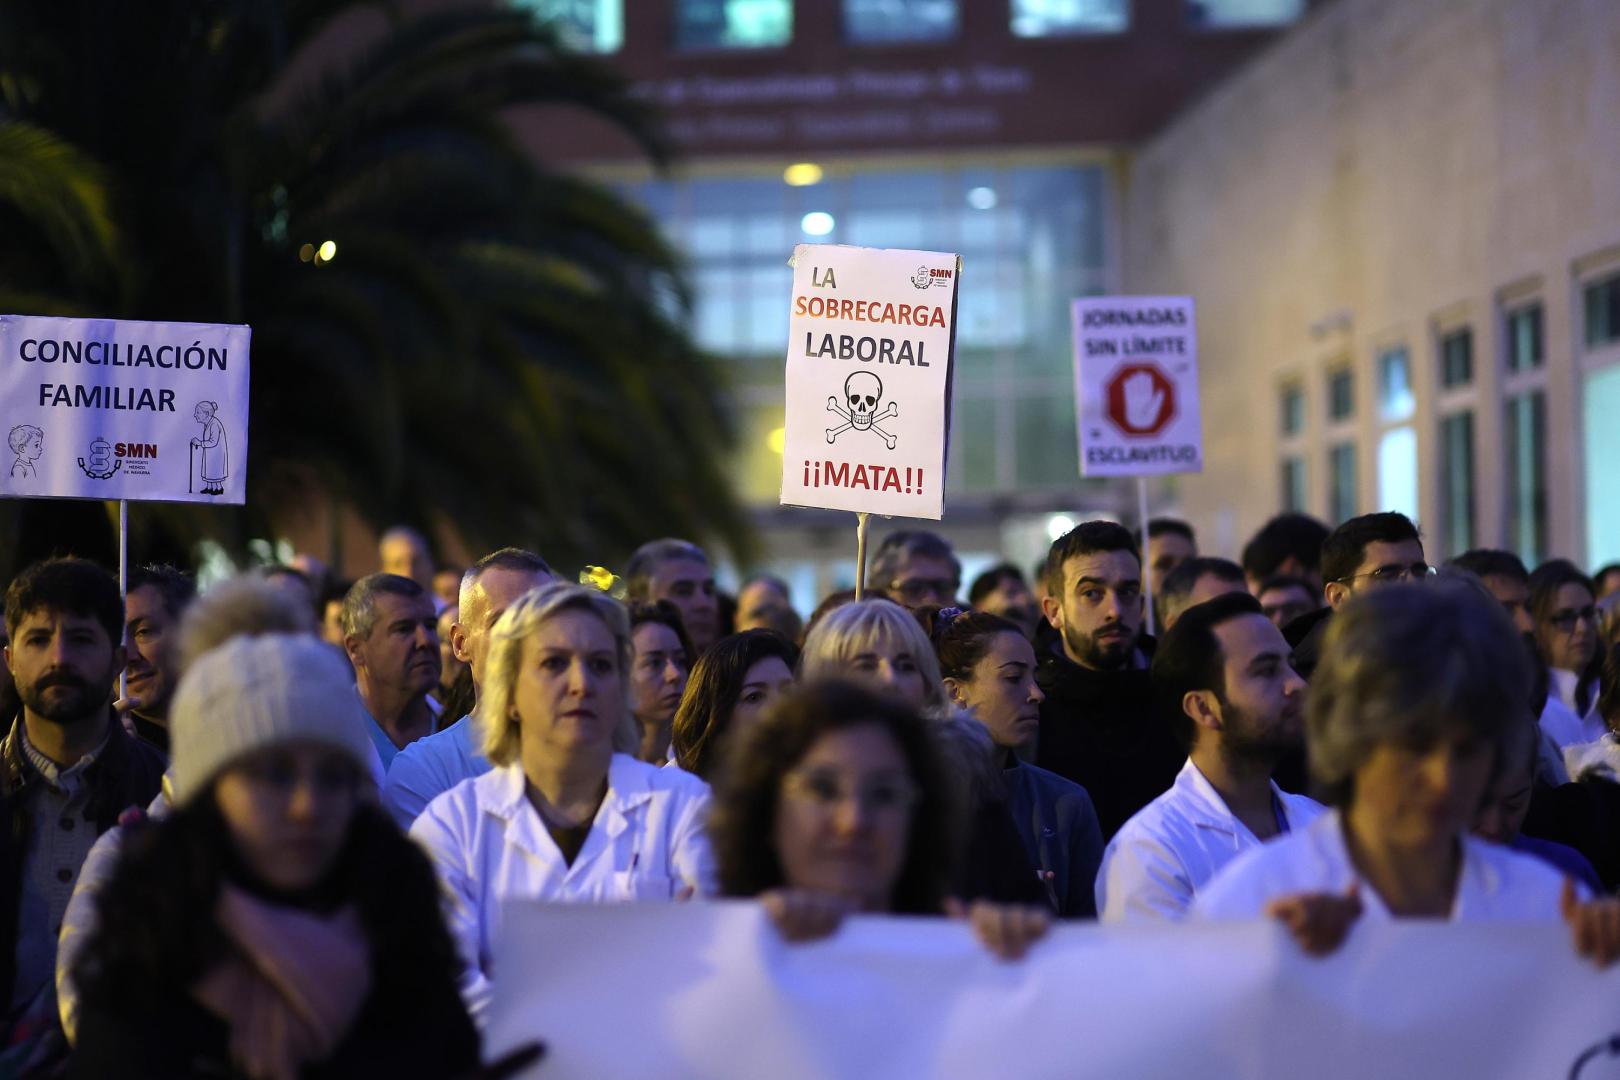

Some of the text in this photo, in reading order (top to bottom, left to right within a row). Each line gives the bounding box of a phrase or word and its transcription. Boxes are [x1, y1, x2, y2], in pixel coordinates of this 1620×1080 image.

[811, 266, 837, 289] LA
[930, 268, 952, 279] SMN
[795, 296, 946, 329] SOBRECARGA
[1083, 308, 1186, 327] JORNADAS
[19, 339, 228, 371] CONCILIACIÓN
[805, 332, 930, 367] LABORAL
[1085, 334, 1185, 357] SIN LÍMITE
[39, 383, 176, 412] FAMILIAR
[114, 442, 158, 459] SMN
[1087, 444, 1197, 463] ESCLAVITUD
